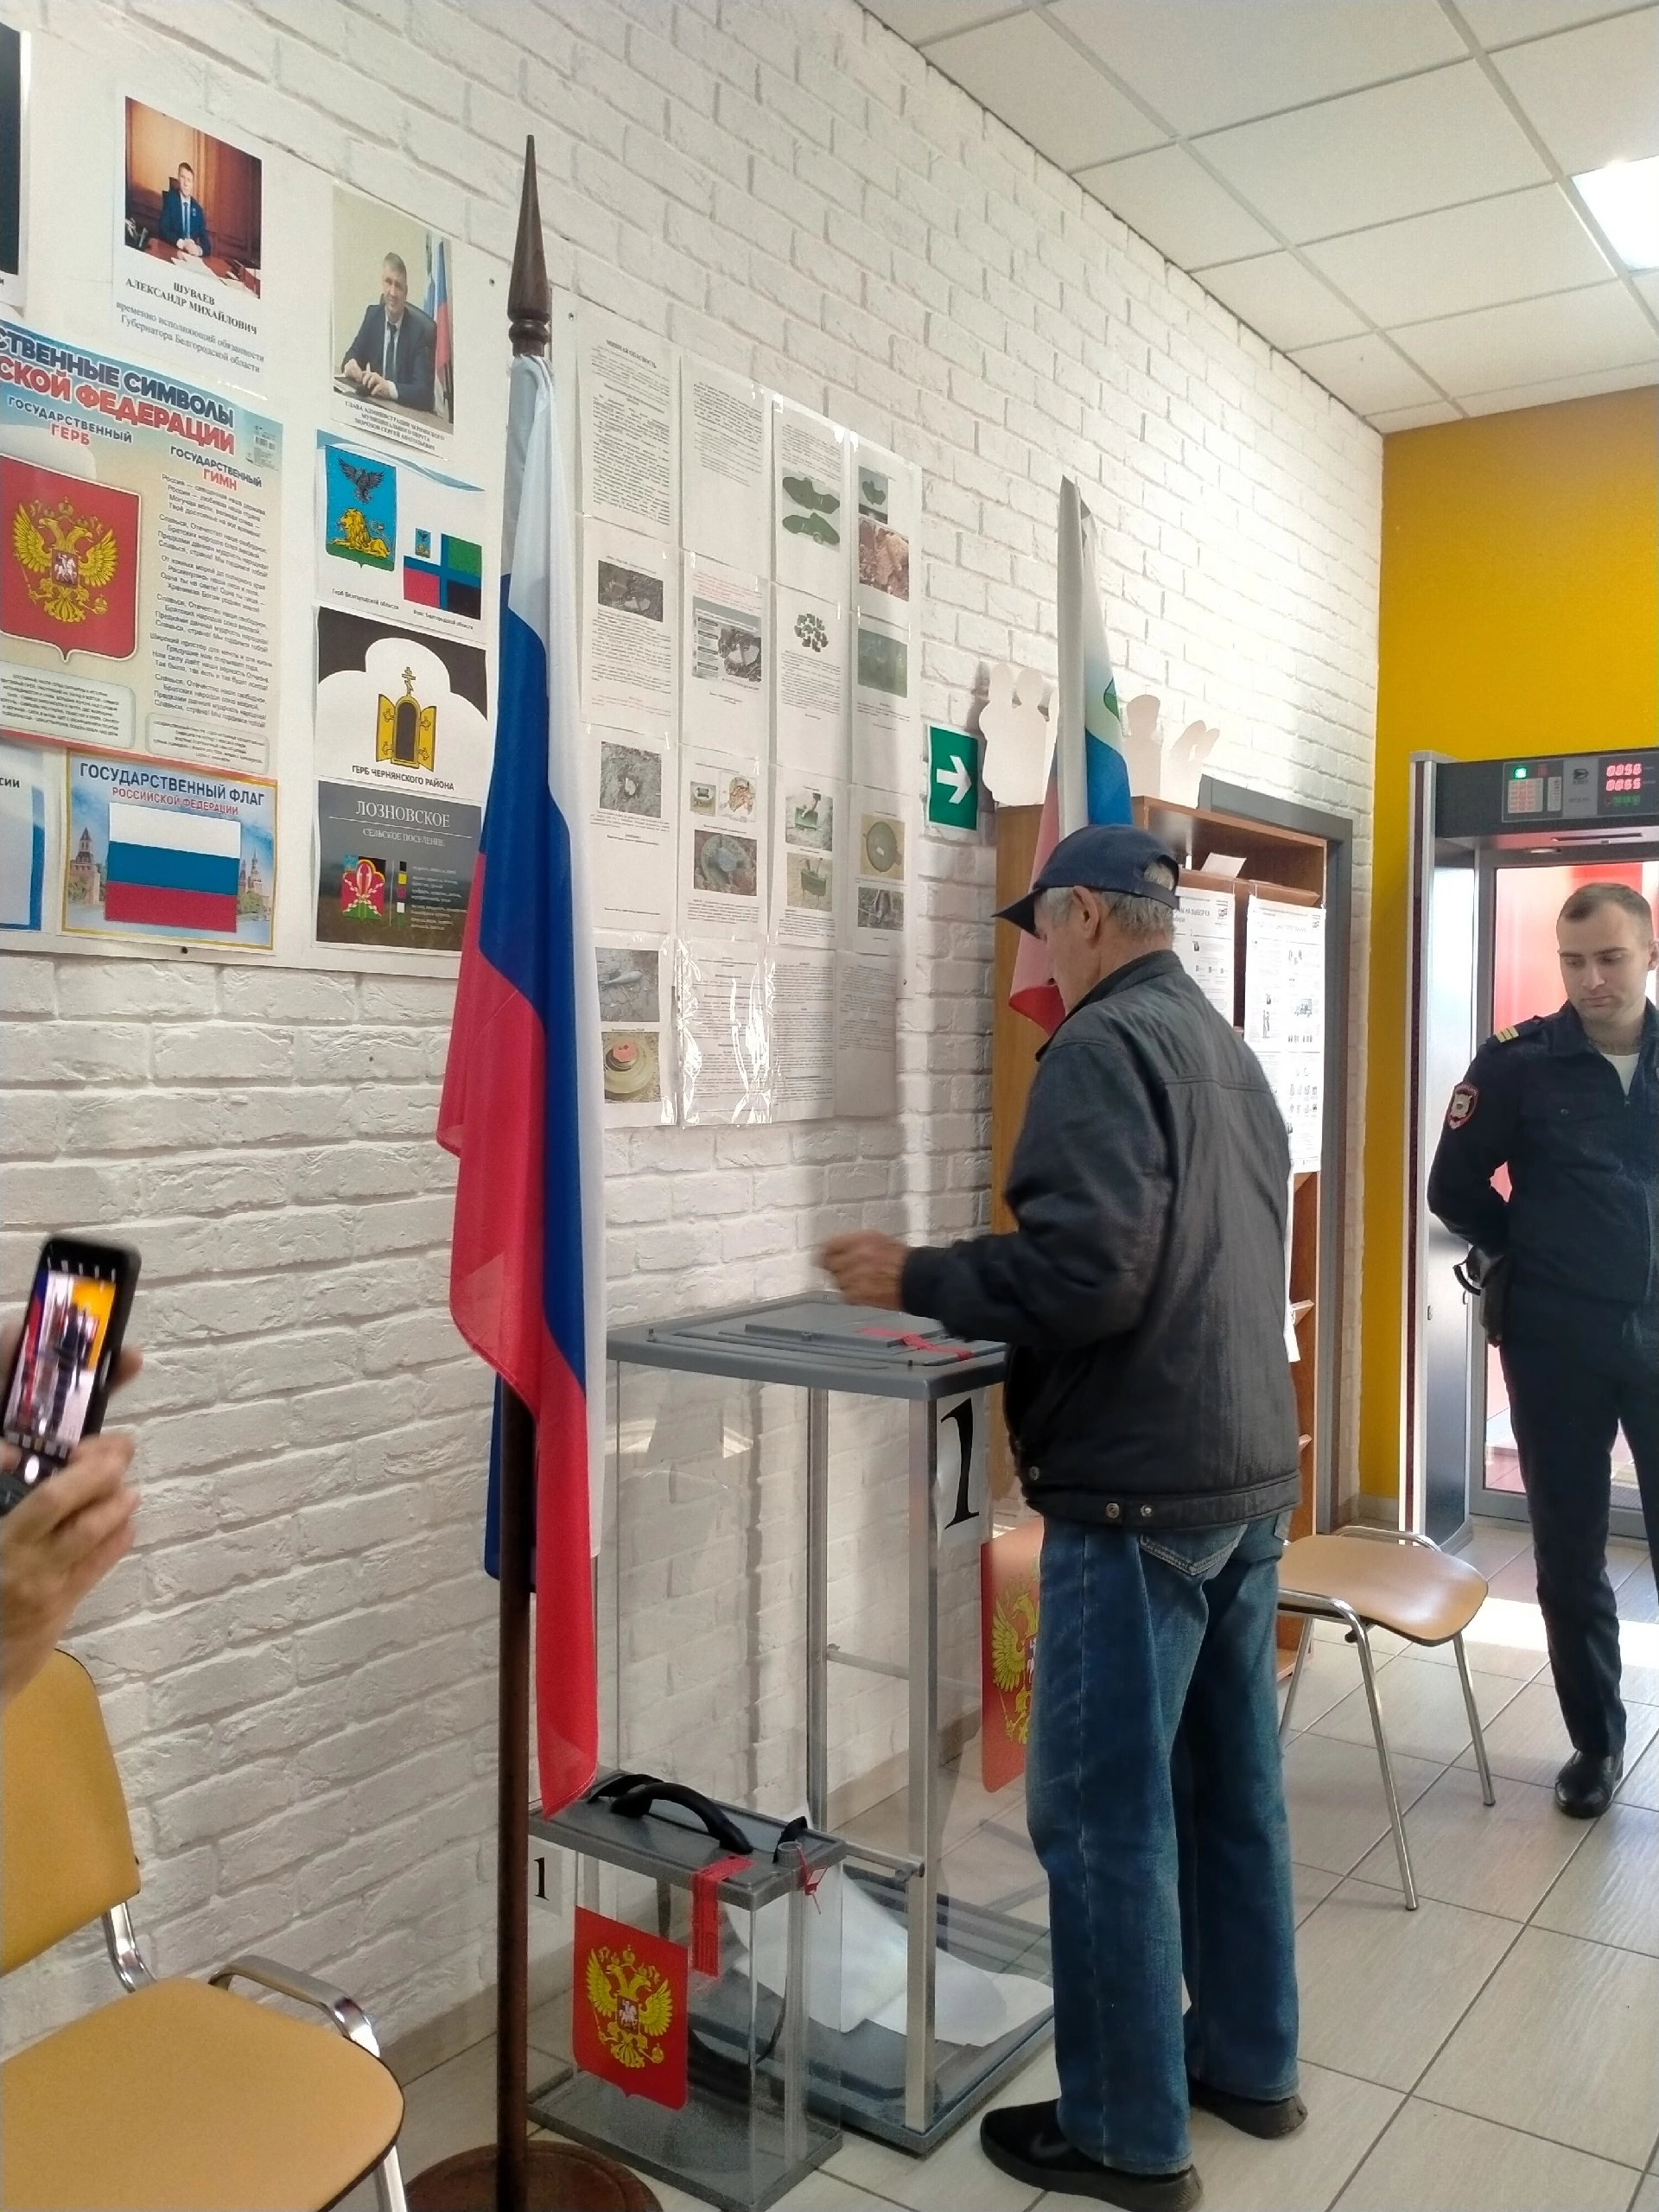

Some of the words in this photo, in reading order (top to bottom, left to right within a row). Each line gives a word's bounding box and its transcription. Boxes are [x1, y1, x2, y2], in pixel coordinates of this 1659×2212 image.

[116, 302, 156, 322] временно
[125, 277, 187, 308] АЛЕКСАНДР
[189, 302, 257, 335] МИХАЙЛОВИЧ
[174, 282, 215, 305] ШУВАЕВ
[121, 315, 173, 341] Губернатора
[175, 334, 228, 362] Белгородской
[230, 355, 260, 373] области
[0, 355, 71, 402] СКОЙ
[76, 385, 235, 455] ФЕДЕРАЦИИ
[9, 397, 132, 443] ГОСУДАРСТВЕННЫЙ
[124, 372, 234, 429] СИМВОЛЫ
[51, 424, 90, 446] ГЕРБ
[170, 446, 262, 488] ГОСУДАРСТВЕННЫЙ
[203, 468, 238, 492] ГИМН
[79, 763, 226, 800] ГОСУДАРСТВЕННЫЙ
[229, 788, 265, 806] ФЛАГ
[352, 765, 370, 775] ГЕРБ
[371, 768, 423, 785] ЧЕРНЯНСКОГО
[425, 778, 454, 791] РАЙОНА
[112, 786, 180, 805] РОССИЙСКОЙ
[182, 798, 238, 816] ФЕДЕРАЦИИ
[356, 800, 450, 828] ЛОЗНОВСКОЕ
[363, 828, 402, 841] СЕЛЬСКОЕ
[403, 830, 445, 847] ПОСЕЛЕНИЕ
[941, 1397, 979, 1530] 1
[533, 1857, 550, 1901] 1
